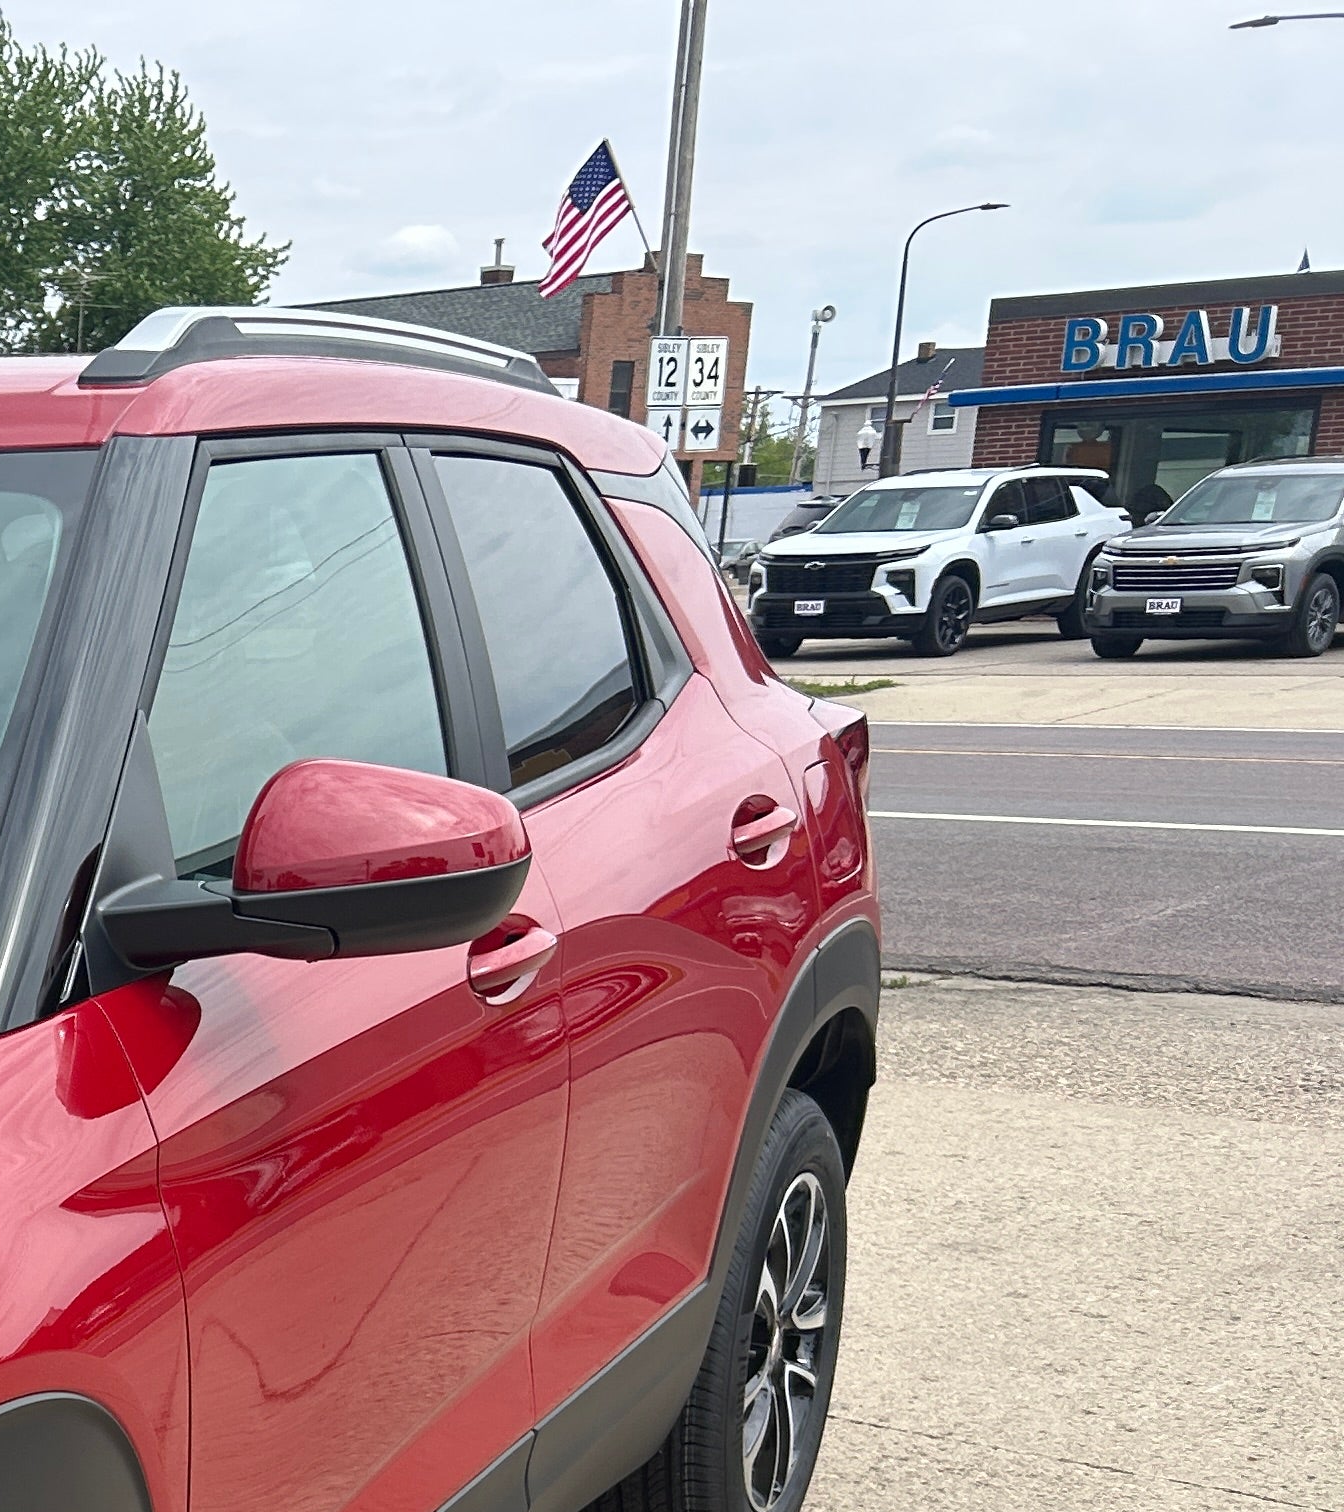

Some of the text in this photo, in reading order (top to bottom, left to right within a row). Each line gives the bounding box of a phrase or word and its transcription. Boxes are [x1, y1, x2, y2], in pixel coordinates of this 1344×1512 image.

[1061, 305, 1278, 373] BRAU
[657, 343, 681, 353] SIBLEY
[696, 343, 720, 353] SIBLEY
[658, 356, 678, 387] 12
[692, 356, 719, 388] 34
[652, 390, 678, 401] COUNTY
[691, 390, 718, 401] COUNTY
[796, 603, 822, 611] BRAU
[1148, 601, 1179, 610] BRAU
